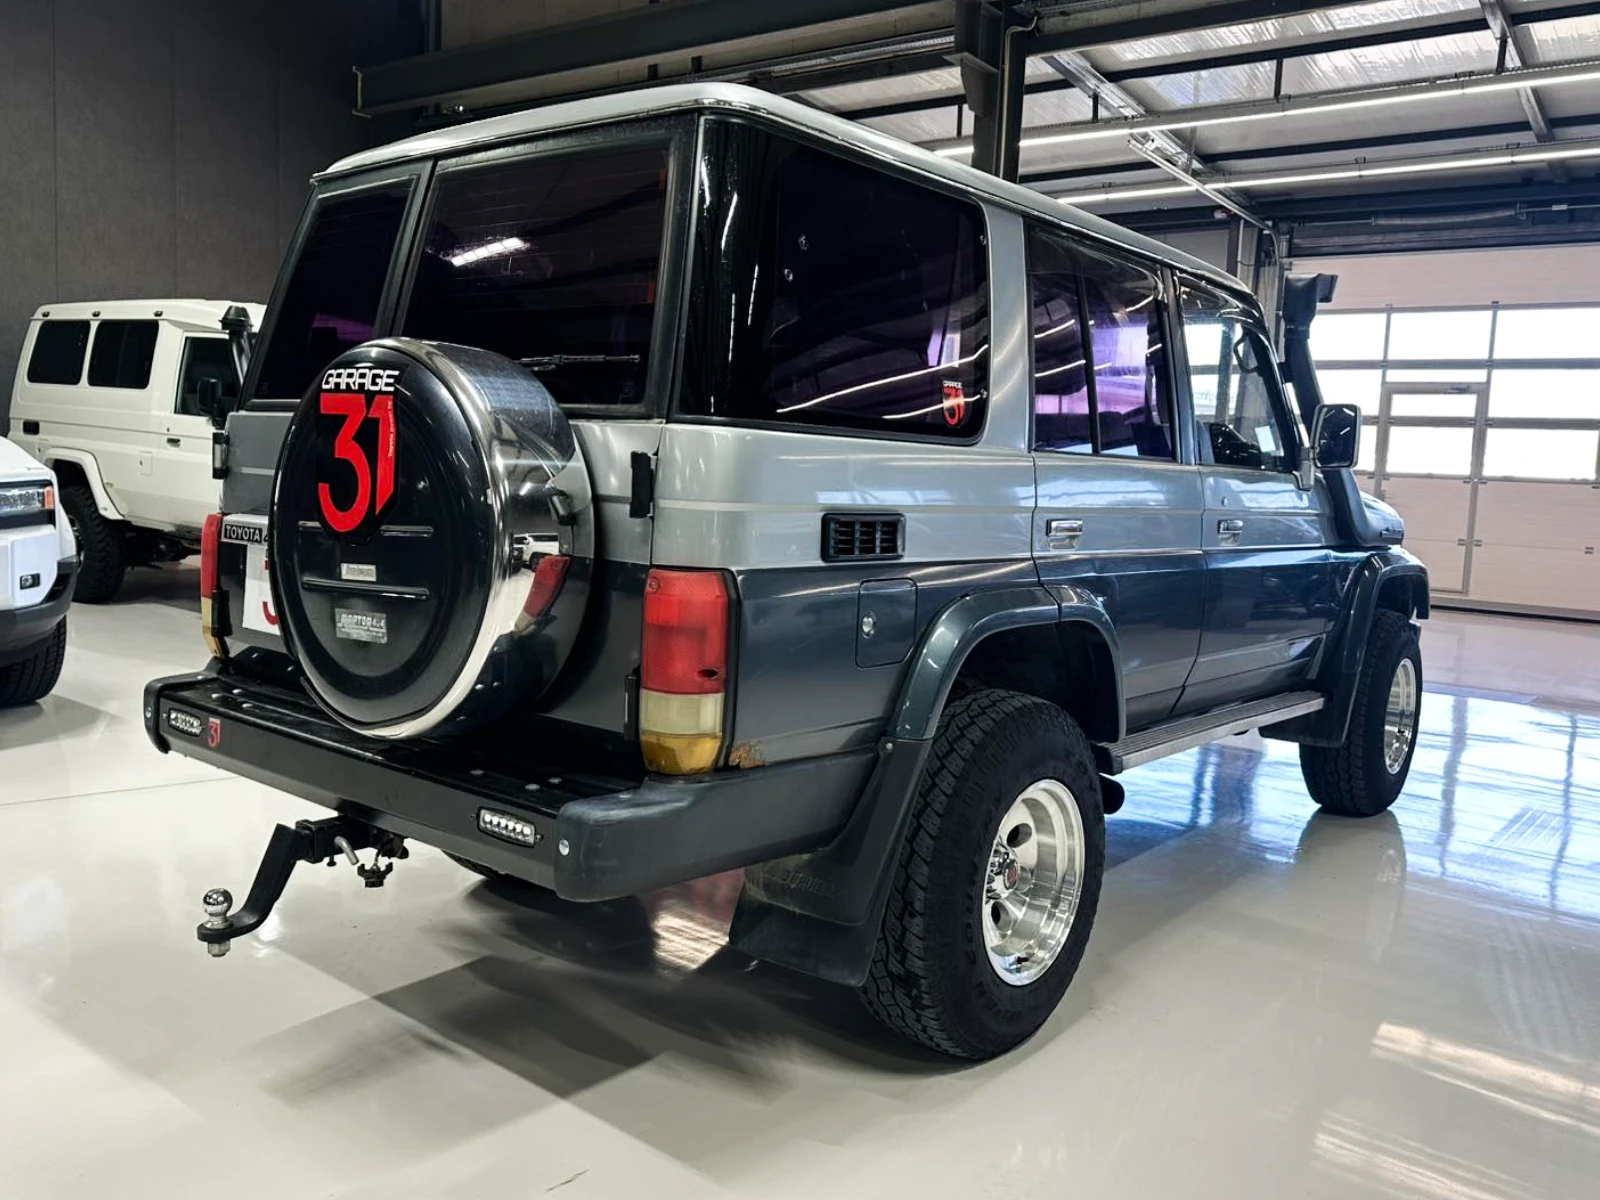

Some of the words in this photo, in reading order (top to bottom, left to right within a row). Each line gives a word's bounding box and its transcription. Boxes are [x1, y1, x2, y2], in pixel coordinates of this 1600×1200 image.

[322, 368, 400, 391] GARAGE
[943, 387, 964, 425] 31
[318, 393, 396, 532] 31
[225, 525, 261, 542] TOYOTA
[208, 721, 220, 748] 31
